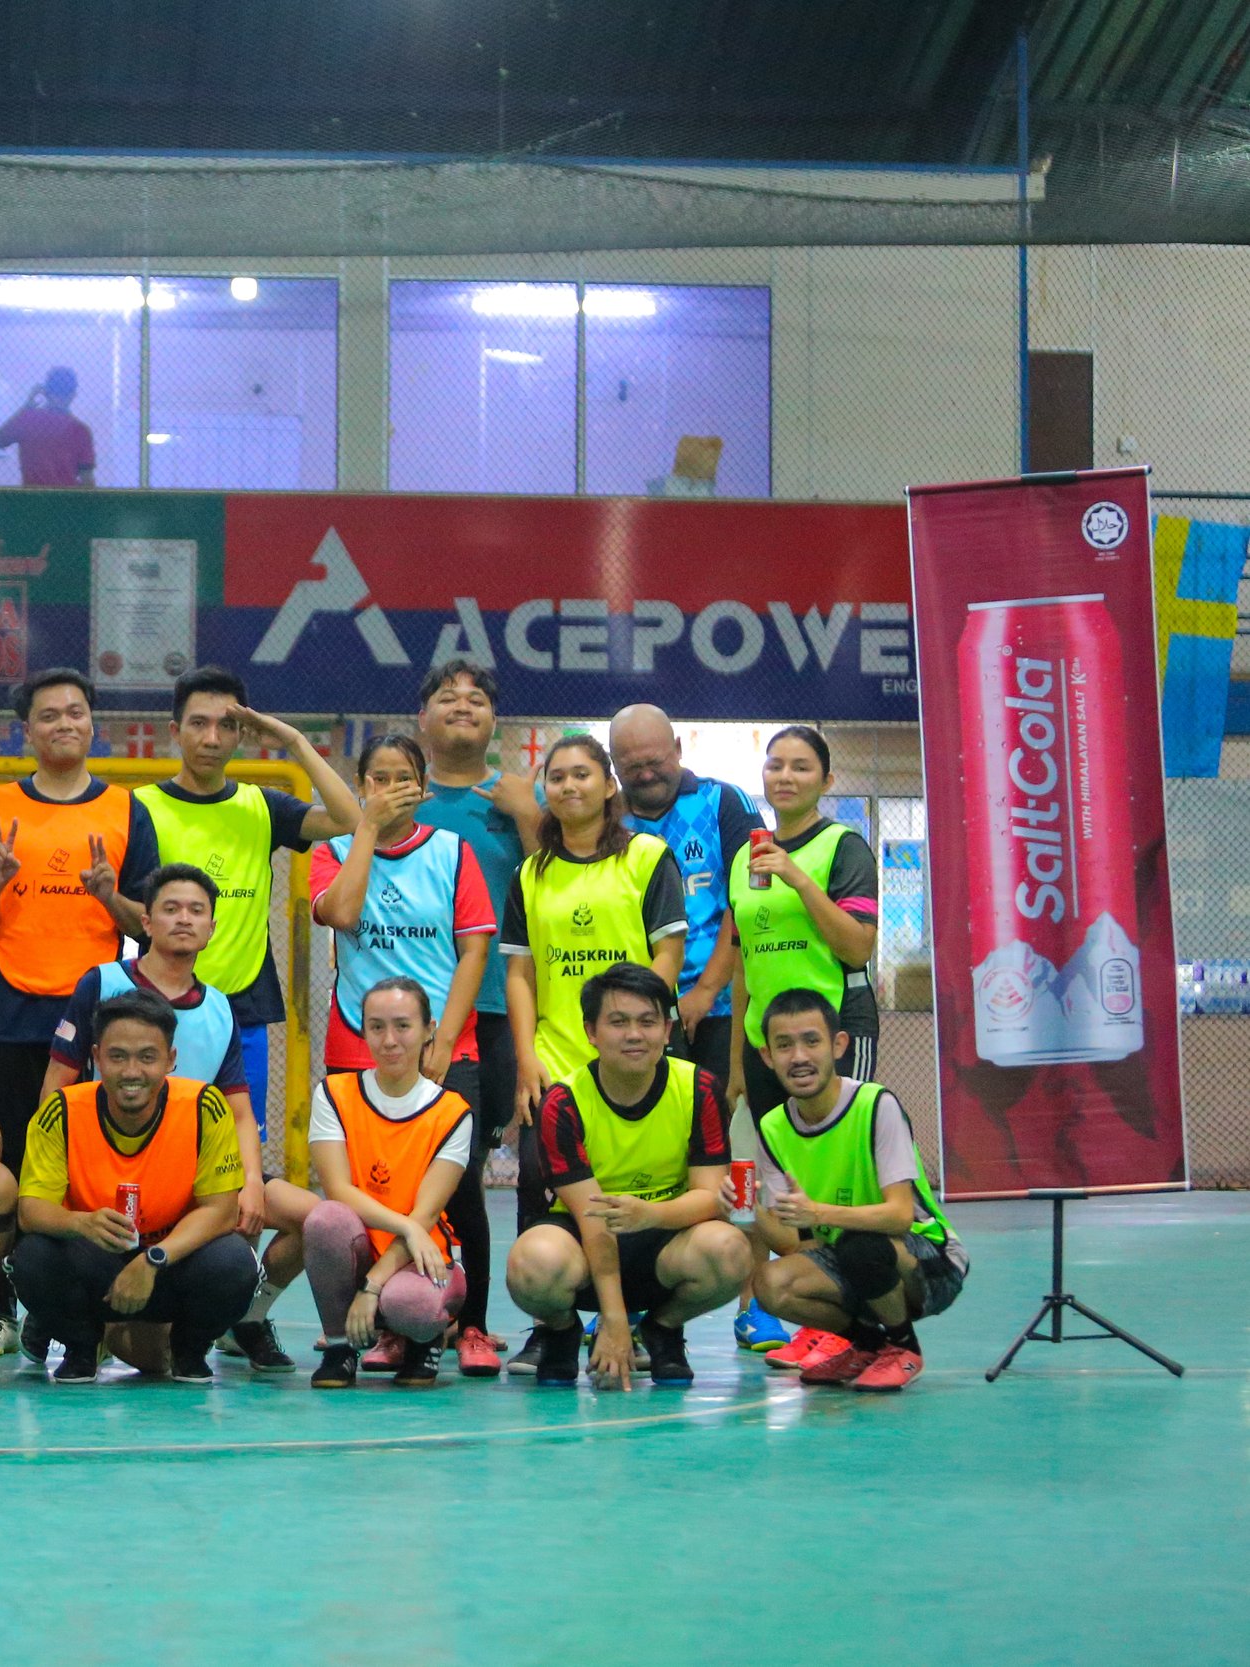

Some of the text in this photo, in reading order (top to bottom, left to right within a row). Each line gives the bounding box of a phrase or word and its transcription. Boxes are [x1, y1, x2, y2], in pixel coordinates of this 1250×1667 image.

[429, 597, 909, 674] ACEPOWE
[1075, 690, 1087, 721] SALT
[1077, 724, 1091, 802] HIMALAYAN
[1004, 657, 1066, 925] SaltCola
[1082, 805, 1093, 840] WITH
[369, 924, 437, 939] AISKRIM
[369, 938, 395, 950] ALI
[755, 940, 808, 954] KAKIJERSI
[561, 950, 627, 962] AISKRIM
[561, 964, 584, 976] ALI
